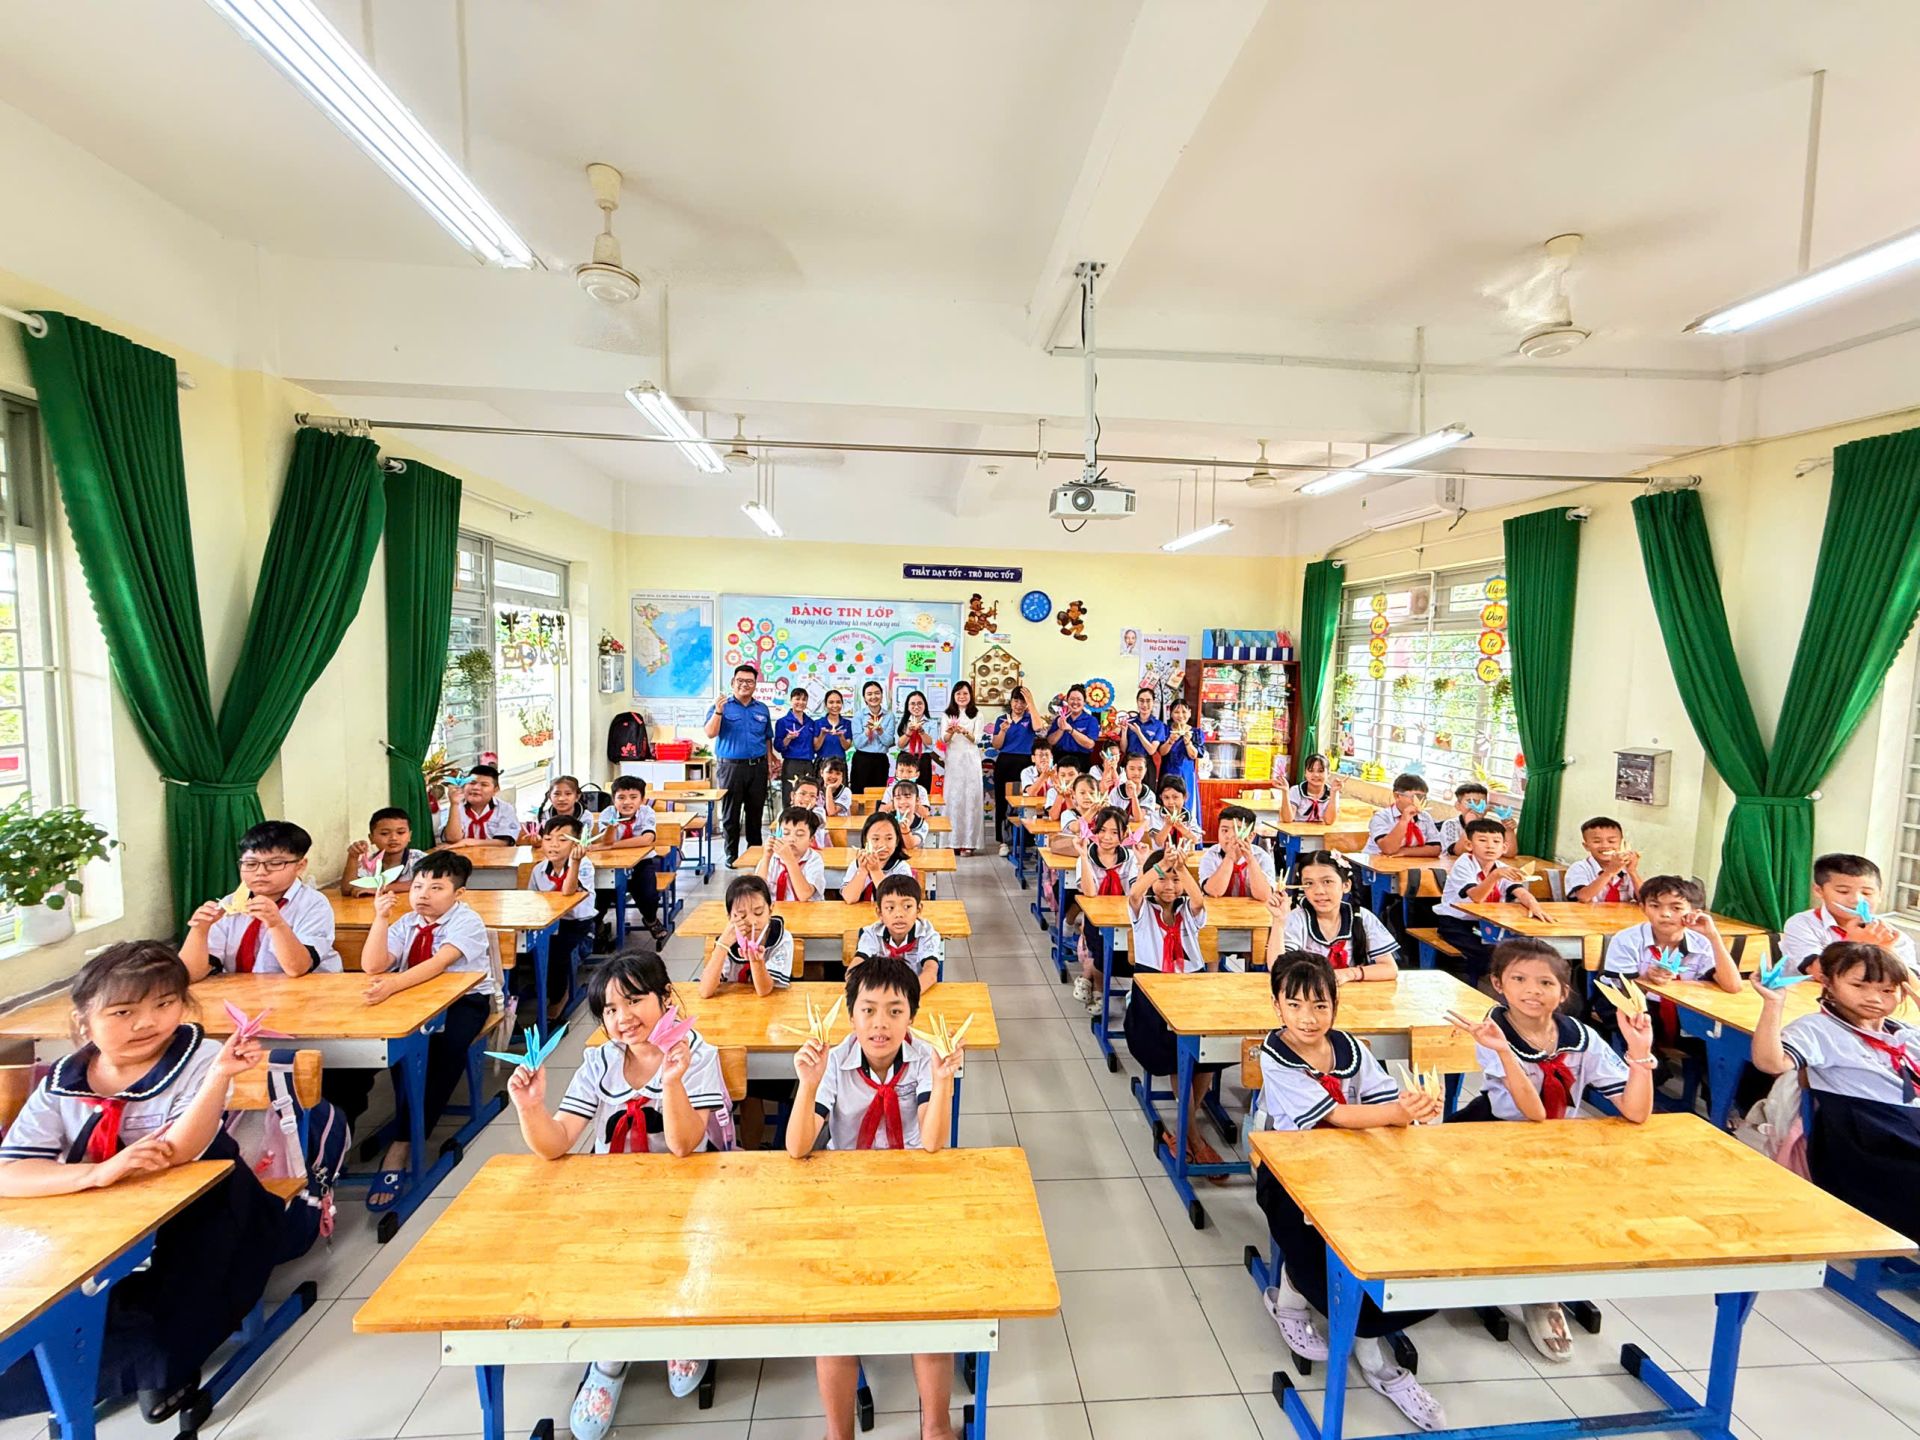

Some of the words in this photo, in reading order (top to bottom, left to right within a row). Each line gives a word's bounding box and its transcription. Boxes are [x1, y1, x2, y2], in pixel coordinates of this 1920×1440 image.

[932, 569, 946, 578] DẠY
[948, 567, 962, 577] TỐT
[968, 569, 982, 578] TRÒ
[984, 571, 999, 579] HỌC
[1000, 570, 1015, 579] TỐT
[791, 602, 833, 617] BẢNG
[836, 607, 862, 617] TIN
[867, 605, 894, 618] LỚP
